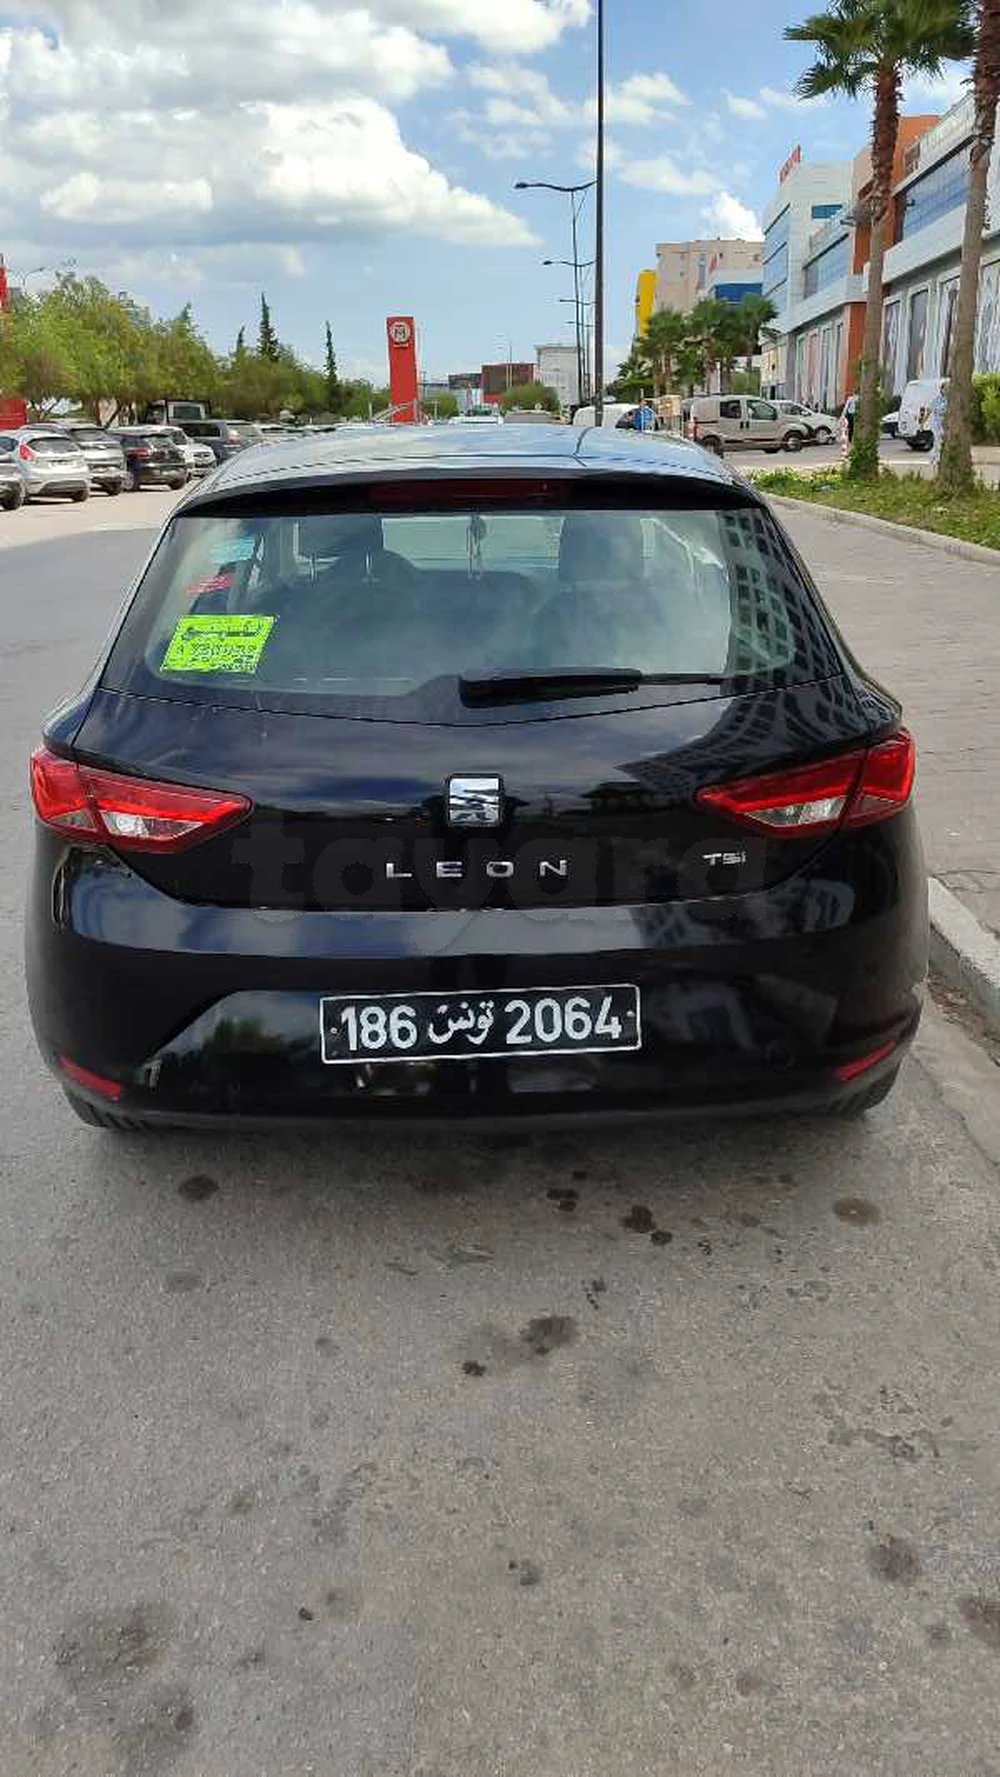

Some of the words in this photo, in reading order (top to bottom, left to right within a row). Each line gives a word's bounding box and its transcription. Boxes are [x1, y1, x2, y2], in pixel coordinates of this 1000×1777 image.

[385, 859, 568, 879] LEON
[340, 1004, 418, 1051] 186
[427, 1000, 495, 1045] تونس
[504, 996, 623, 1046] 2064
